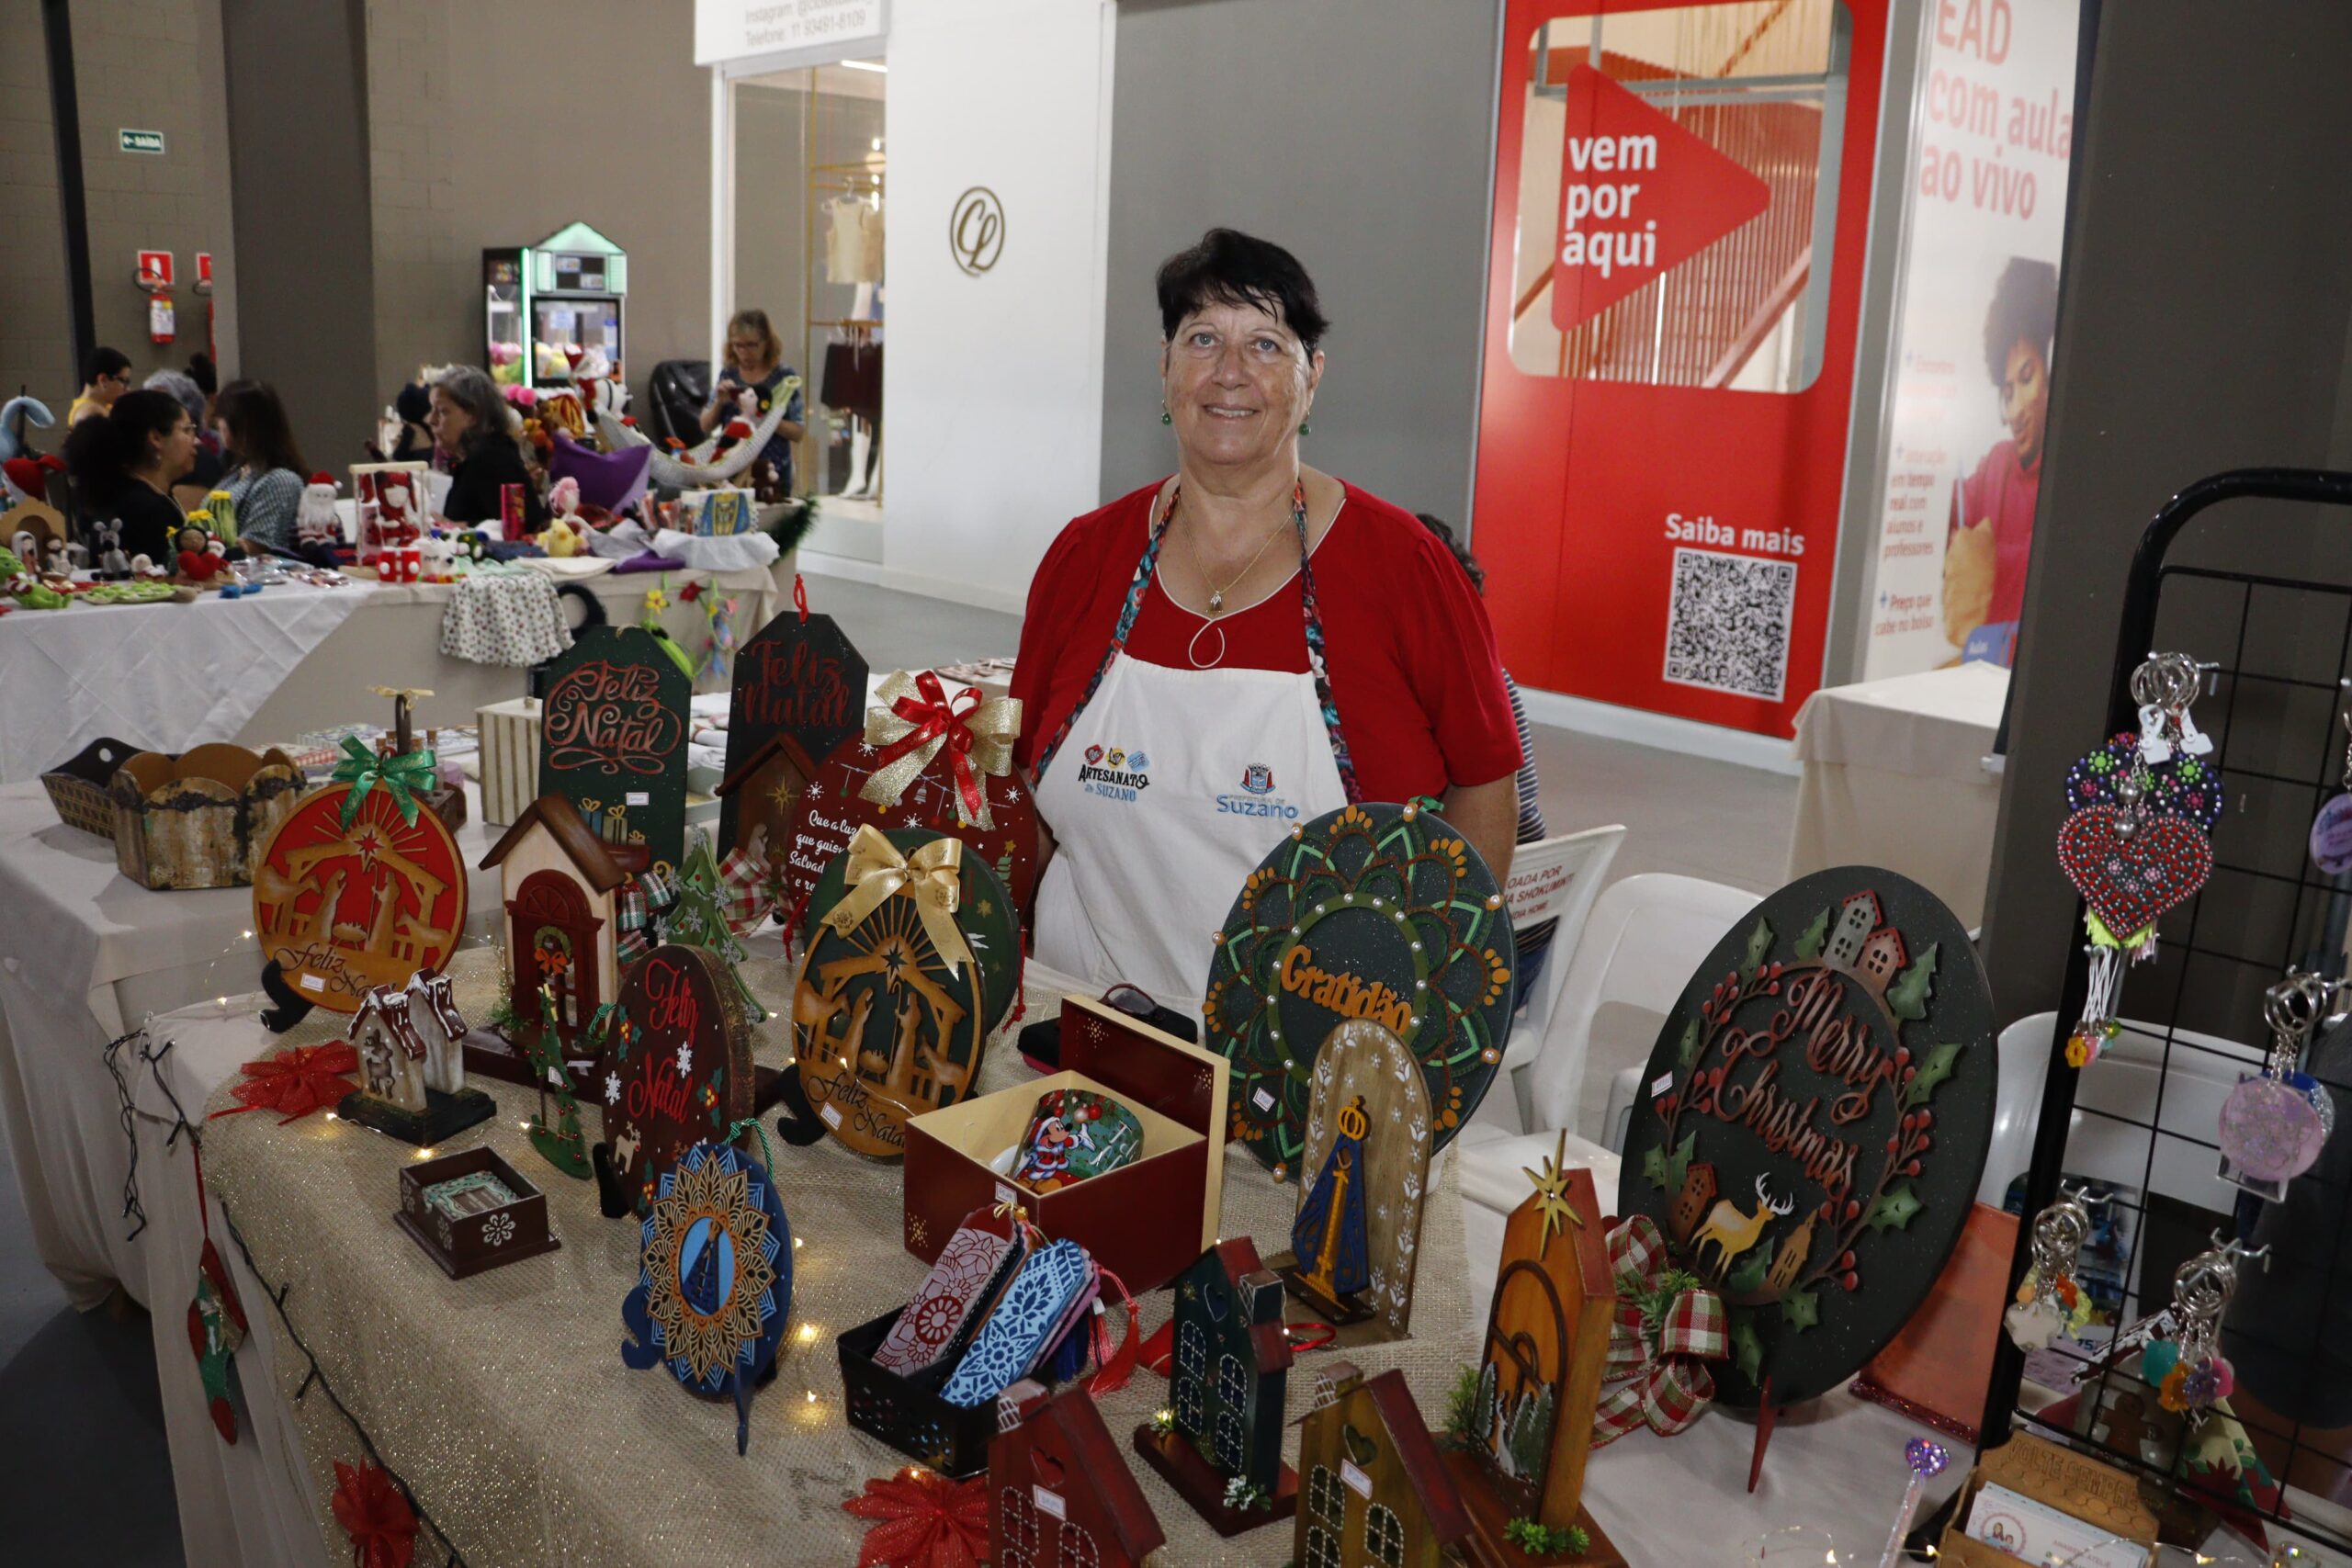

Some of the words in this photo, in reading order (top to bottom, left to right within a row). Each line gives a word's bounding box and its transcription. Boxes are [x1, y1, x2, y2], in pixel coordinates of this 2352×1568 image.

[1936, 0, 2012, 65] EAD
[1929, 68, 2000, 140] com
[1568, 135, 1657, 173] vem
[1920, 144, 1963, 203] ao
[1973, 142, 2037, 220] vivo
[1566, 184, 1641, 231] por
[1563, 220, 1657, 279] aqui
[1665, 513, 1736, 547] Saiba
[1742, 526, 1805, 556] mais
[554, 659, 662, 719] Feliz
[751, 639, 844, 699] Feliz
[739, 682, 854, 728] Natal
[1078, 764, 1150, 790] ARTESANATO
[1095, 783, 1136, 802] SUZANO
[808, 809, 830, 829] Que
[831, 820, 838, 830] a
[1216, 794, 1299, 819] Suzano
[789, 851, 826, 874] Salvad
[795, 833, 815, 850] que
[795, 878, 802, 887] e
[1507, 873, 1539, 889] OADA
[275, 942, 346, 973] Feliz
[646, 958, 698, 1049] Feliz
[1281, 944, 1412, 1037] Gratidão
[1769, 969, 1887, 1126] Merry
[628, 1051, 693, 1123] Natal
[807, 1071, 870, 1109] Feliz
[853, 1107, 905, 1149] Nata
[1713, 1038, 1860, 1203] Christmas
[2007, 1438, 2064, 1483] VOLTE
[2065, 1459, 2141, 1515] SEMPRE
